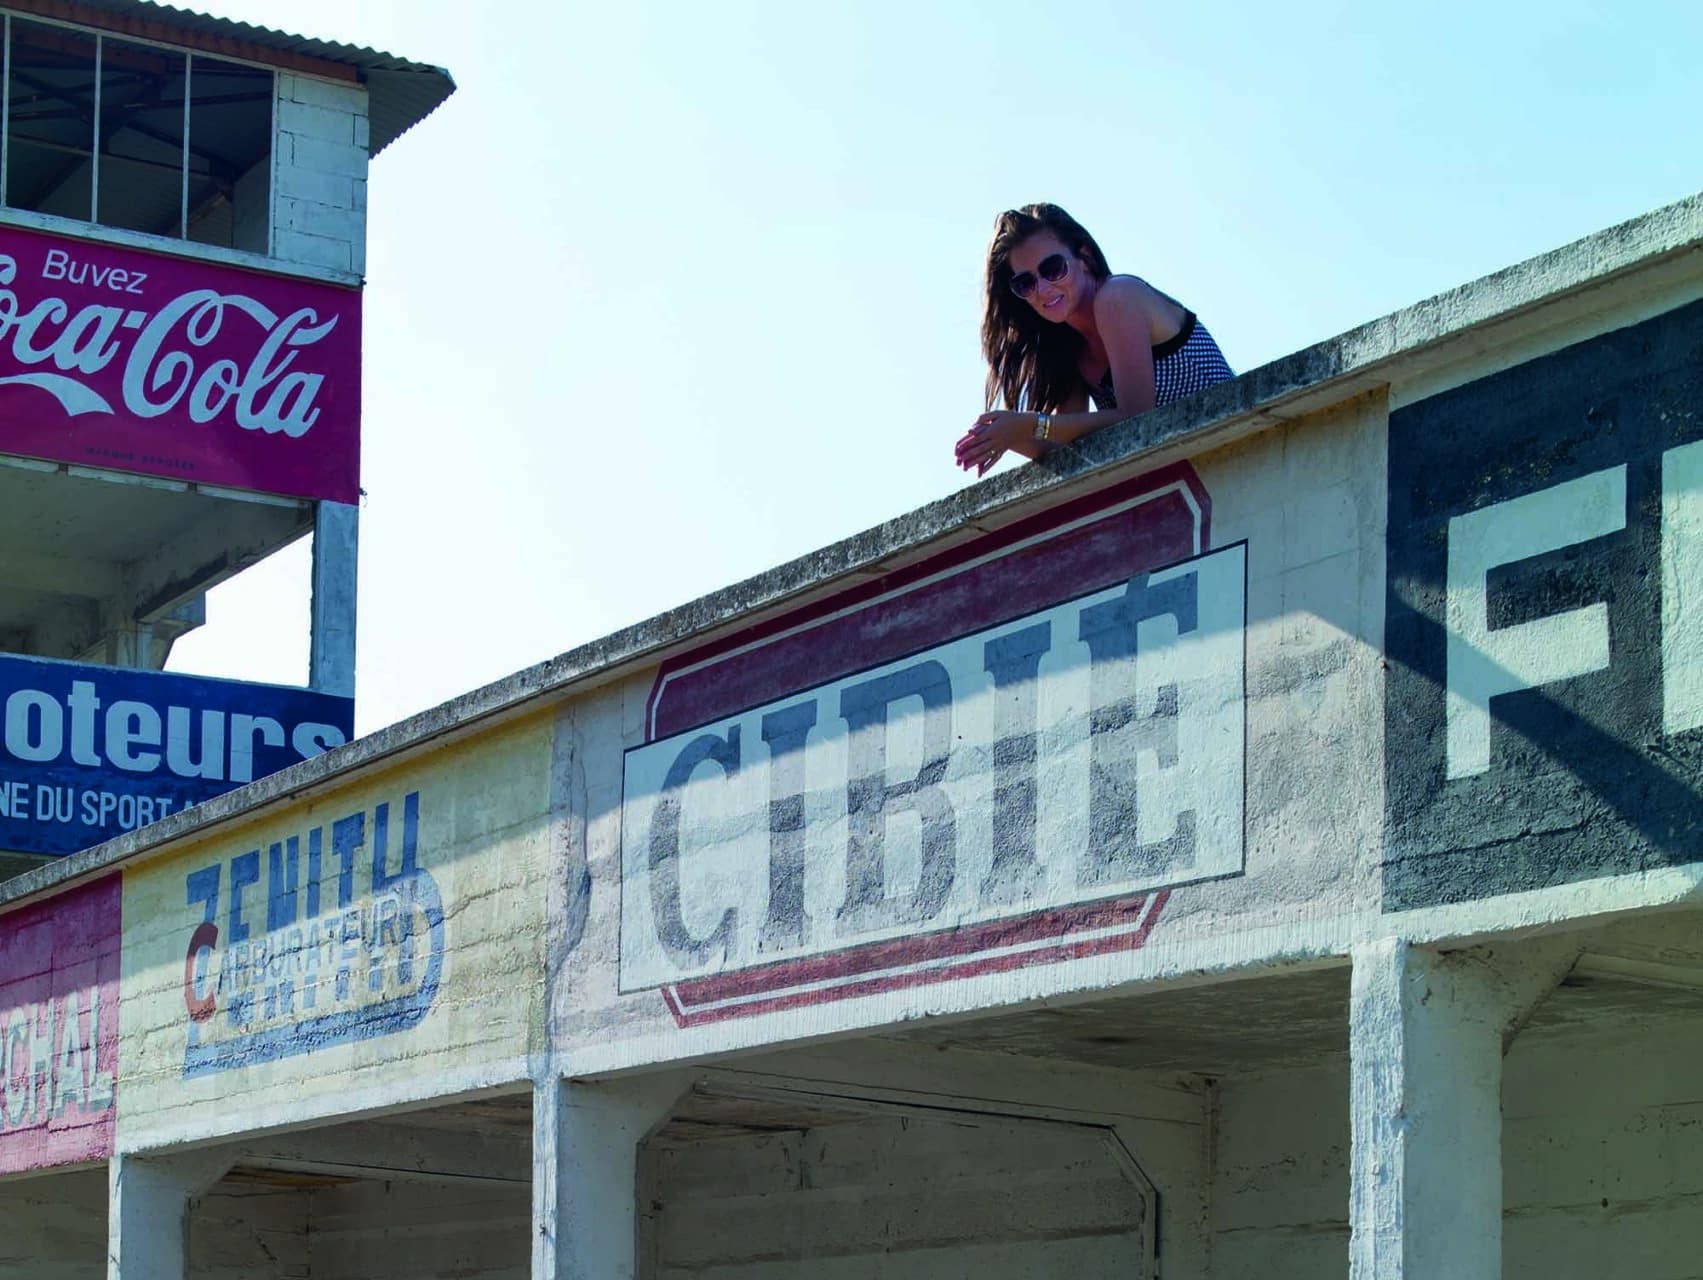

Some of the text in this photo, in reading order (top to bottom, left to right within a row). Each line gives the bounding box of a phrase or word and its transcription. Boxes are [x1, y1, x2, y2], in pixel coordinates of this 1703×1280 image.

[42, 249, 148, 294] Buvez
[0, 256, 338, 438] ca-Cola
[37, 785, 73, 823] DU
[81, 790, 172, 829] SPORT
[0, 985, 114, 1127] CHAL
